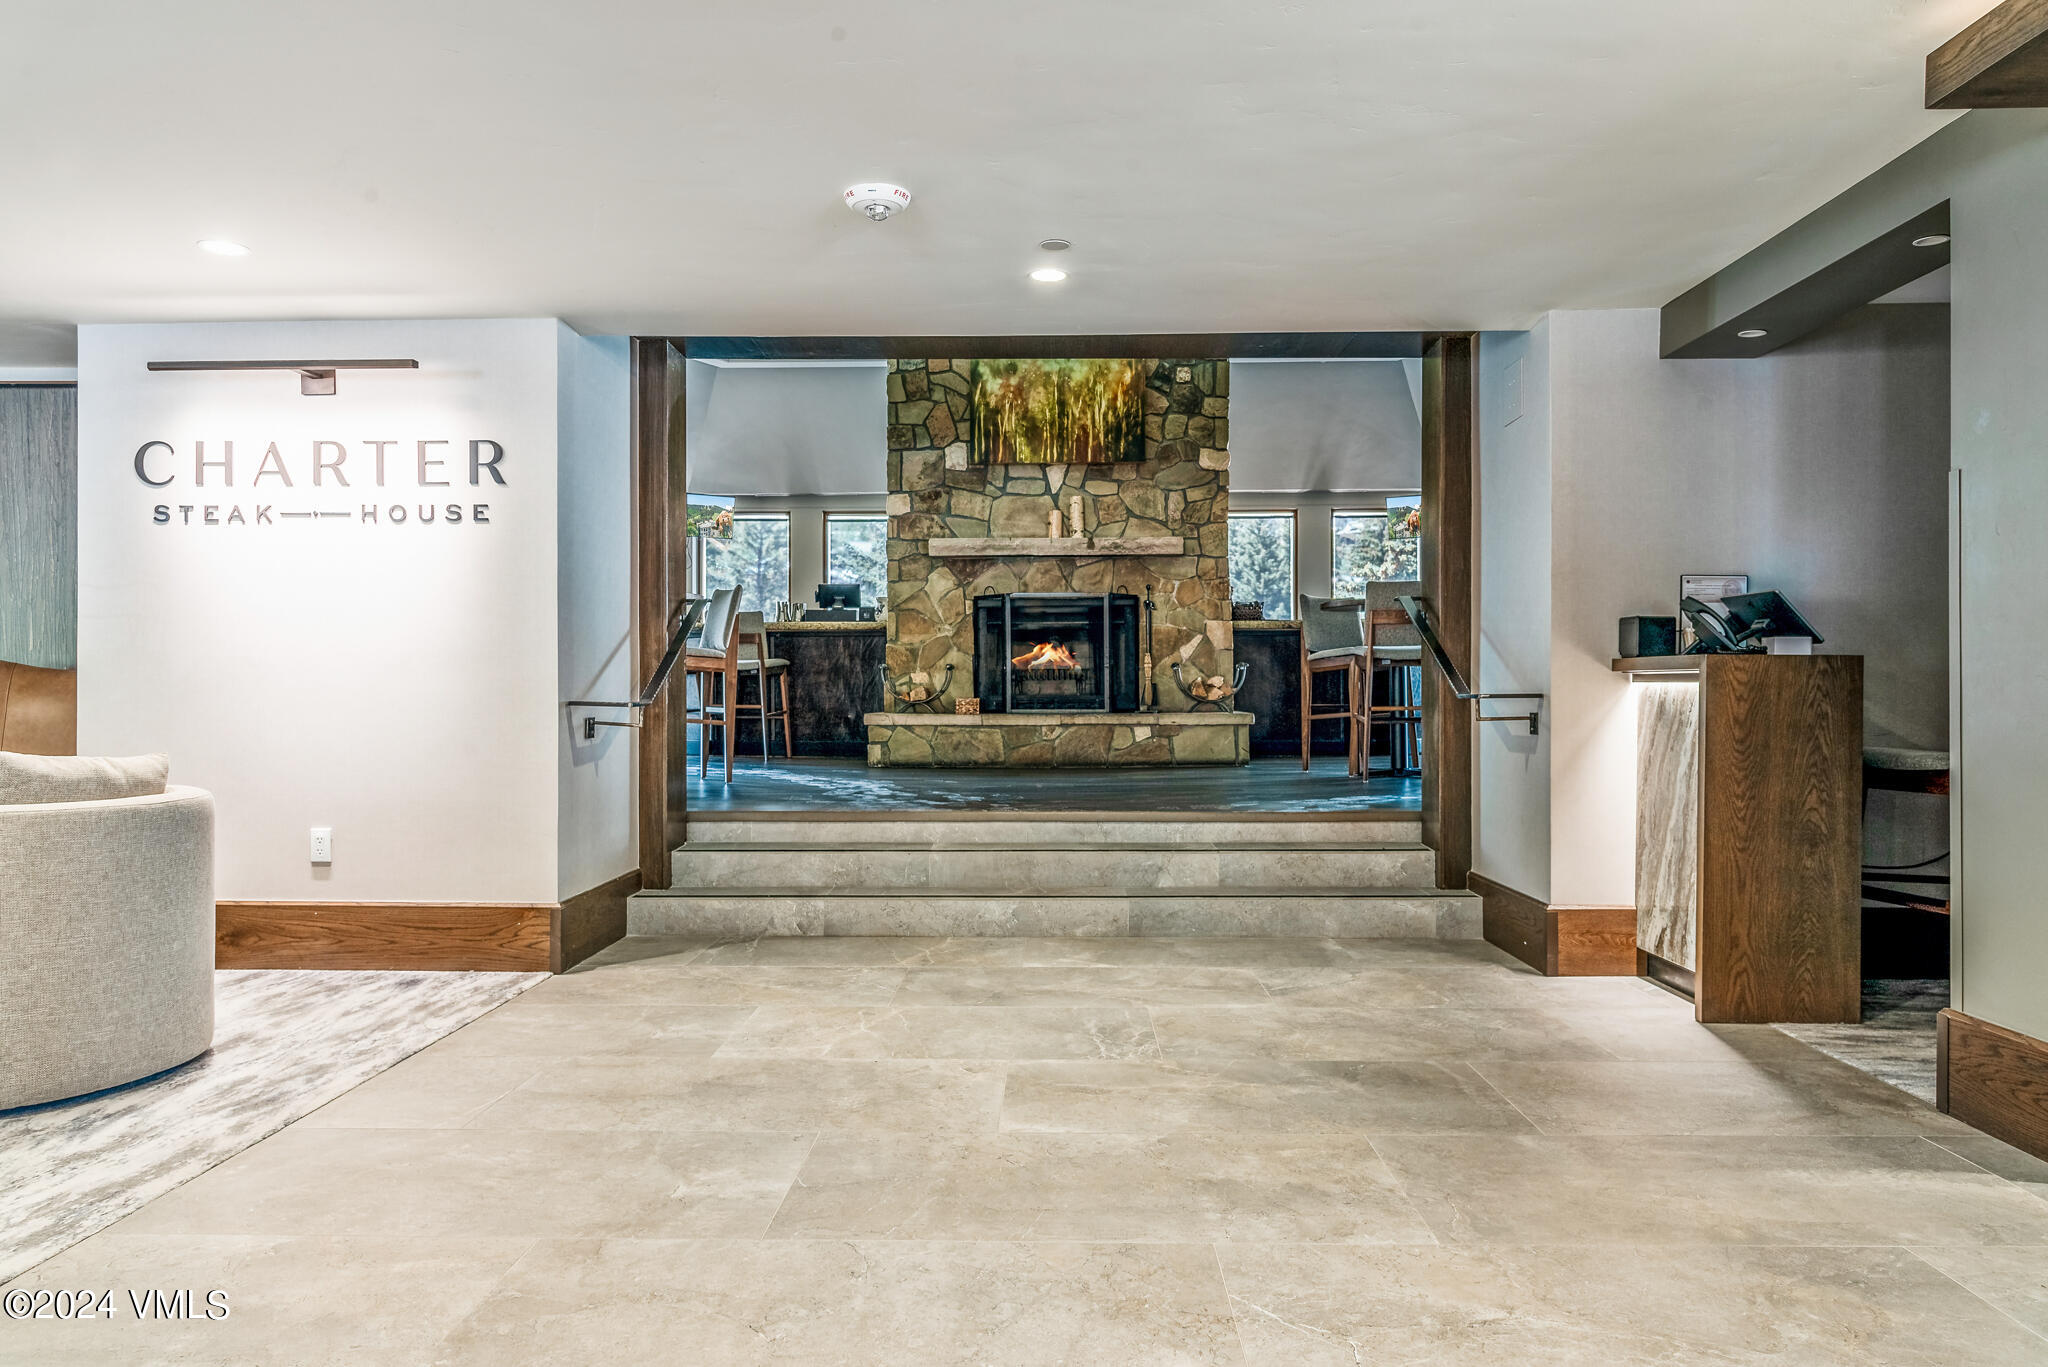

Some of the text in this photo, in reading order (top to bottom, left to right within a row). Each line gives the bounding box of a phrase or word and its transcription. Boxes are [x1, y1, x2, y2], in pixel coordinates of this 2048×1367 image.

[894, 189, 909, 201] FIRE
[134, 440, 509, 488] CHARTER
[153, 503, 490, 525] STEAK HOUSE
